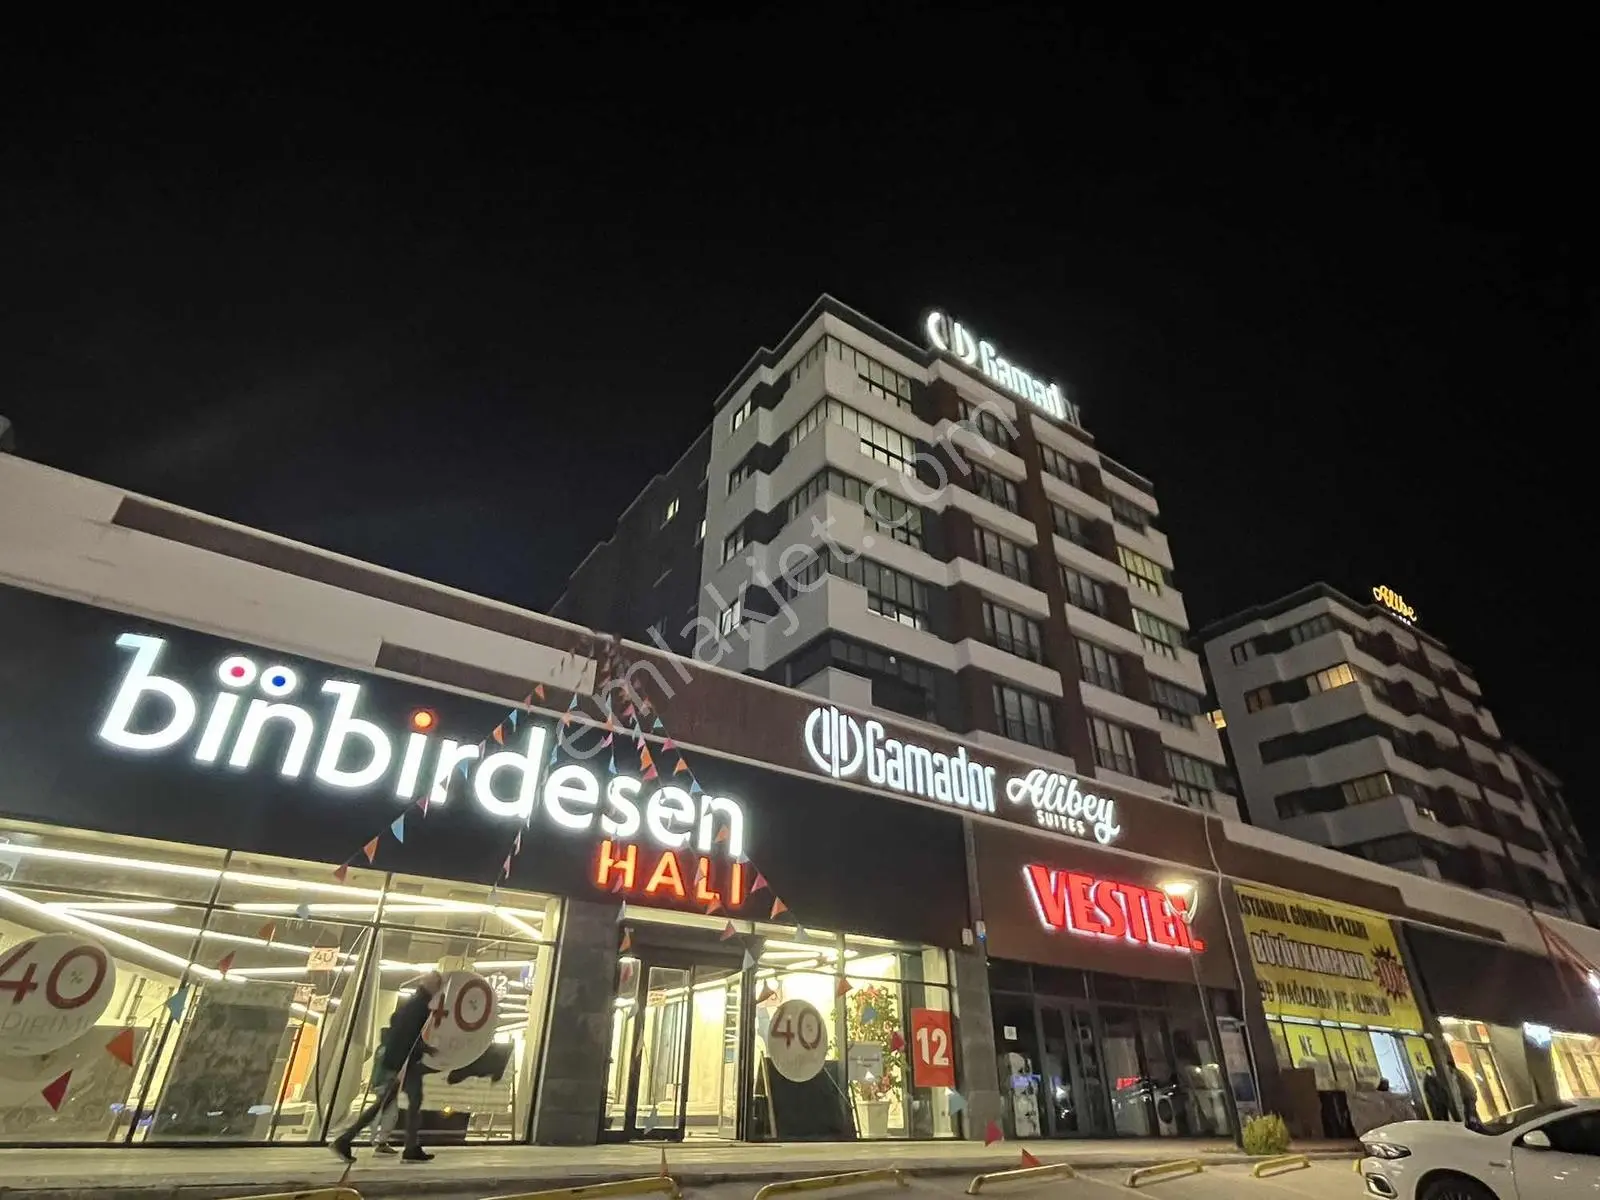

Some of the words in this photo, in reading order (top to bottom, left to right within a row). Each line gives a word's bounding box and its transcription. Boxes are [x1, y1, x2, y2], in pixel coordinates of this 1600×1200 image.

[99, 632, 746, 857] binbirdesen
[866, 720, 996, 813] Gamador
[1006, 769, 1120, 844] Alibey
[1036, 809, 1085, 837] SUITES
[597, 840, 742, 904] HALI
[1023, 864, 1206, 952] VESTEL
[771, 1004, 822, 1051] 40
[917, 1028, 949, 1066] 12
